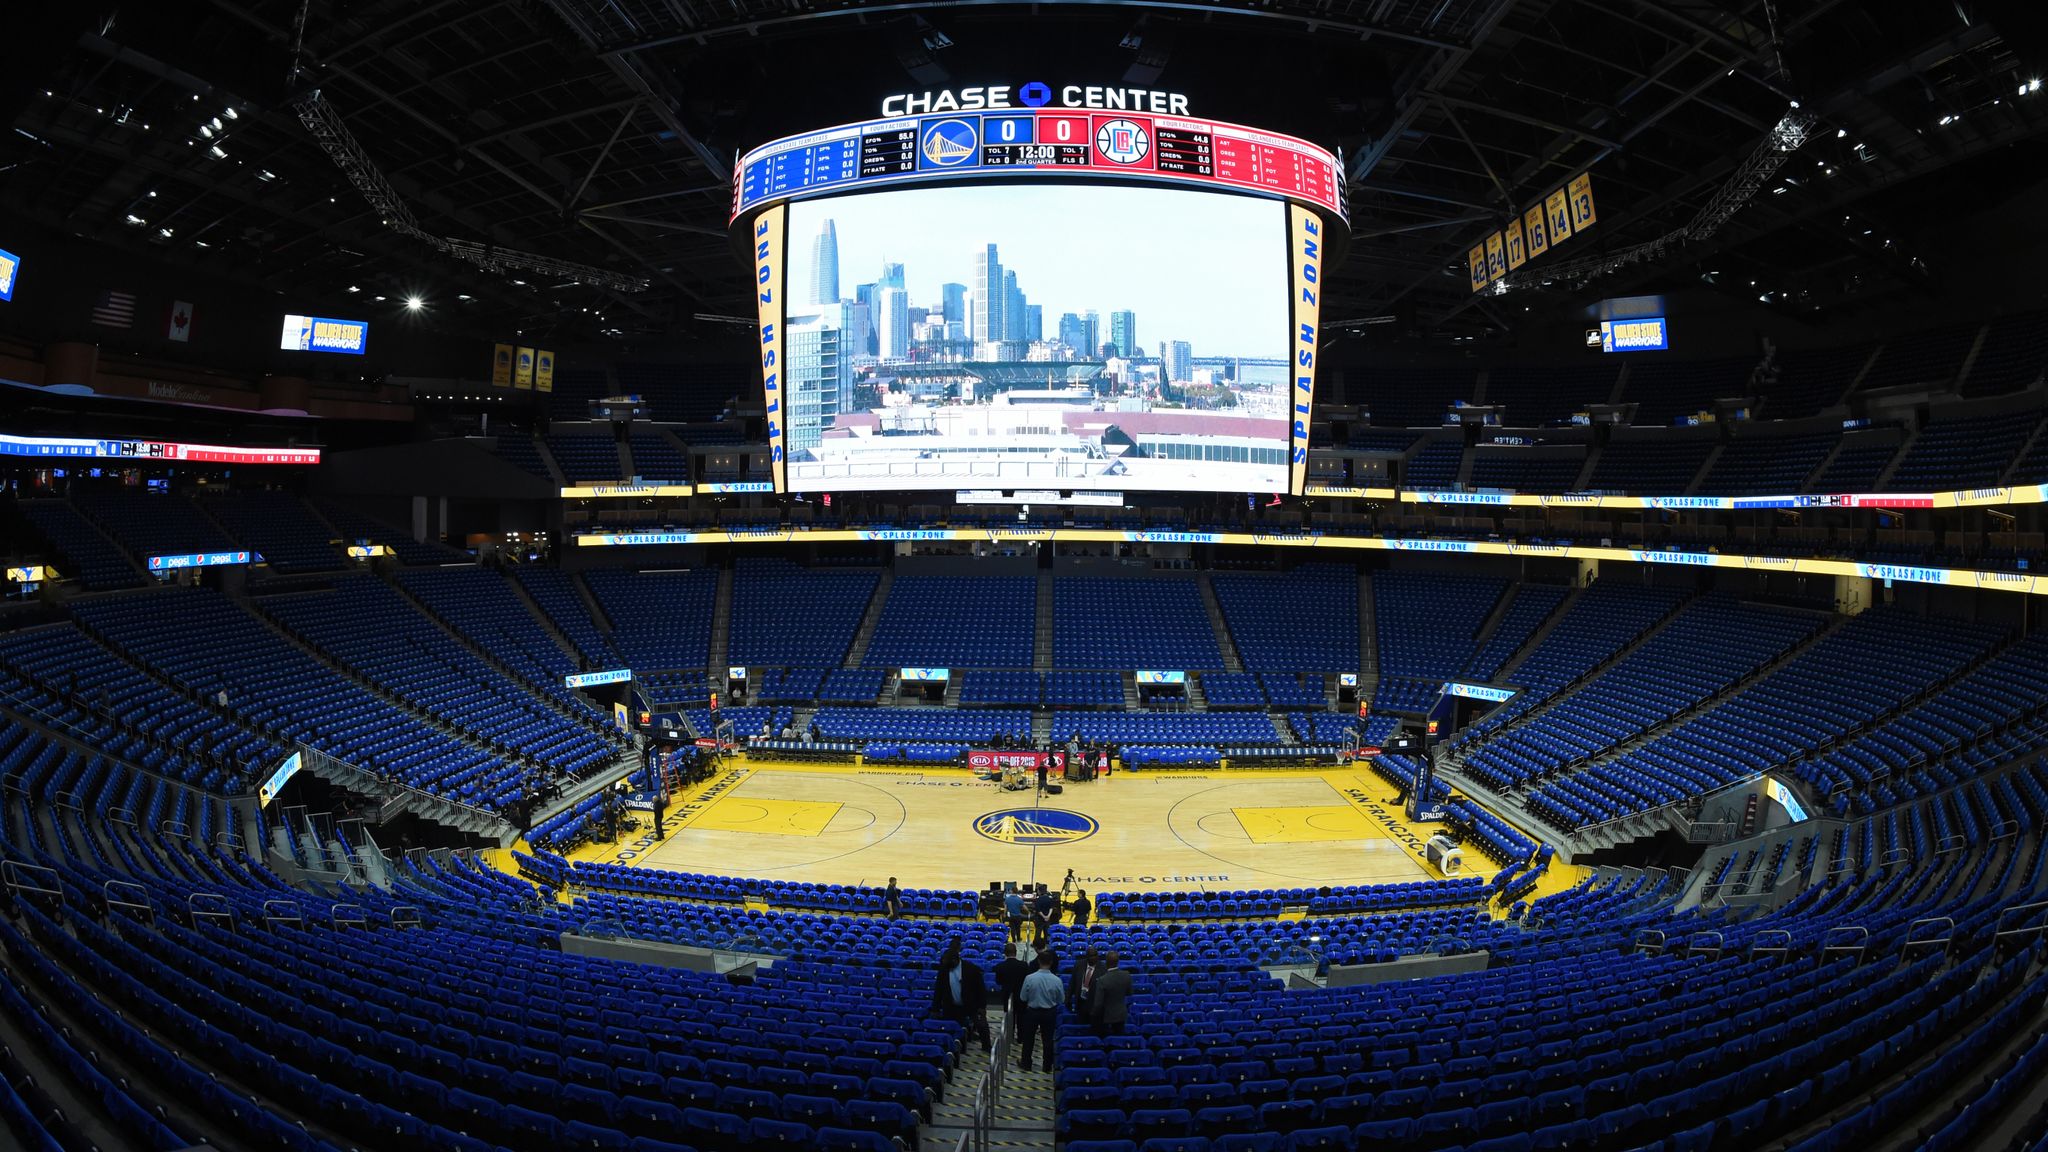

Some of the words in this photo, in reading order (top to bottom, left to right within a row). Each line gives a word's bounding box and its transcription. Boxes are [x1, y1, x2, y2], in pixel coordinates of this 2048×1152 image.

[882, 86, 1010, 117] CHASE
[1062, 86, 1190, 116] CENTER
[1002, 120, 1015, 140] 0
[1056, 120, 1070, 140] 0
[843, 150, 854, 158] 0.0
[1018, 146, 1055, 158] 12:00
[842, 160, 853, 168] 0.0
[901, 162, 912, 170] 0.0
[842, 170, 852, 178] 0.0
[1575, 194, 1590, 224] 13
[1552, 209, 1566, 238] 14
[1530, 224, 1543, 250] 16
[1510, 236, 1520, 262] 17
[757, 220, 772, 307] ZONE
[1303, 218, 1318, 307] ZONE
[1489, 248, 1504, 274] 24
[1473, 261, 1485, 284] 42
[314, 322, 342, 339] GOLDEN
[342, 325, 363, 340] STATE
[1641, 322, 1661, 337] STATE
[313, 336, 361, 350] WARRIORS
[1616, 336, 1662, 347] WARRIORS
[149, 382, 176, 398] Modelo
[762, 324, 781, 464] SPLASH
[1293, 323, 1315, 465] SPLASH
[168, 556, 190, 568] pepsi
[211, 554, 231, 565] pepsi
[1654, 553, 1684, 562] SPLASH
[1688, 555, 1708, 564] ZONE
[1881, 567, 1915, 579] SPLASH
[1920, 570, 1941, 581] ZONE
[581, 674, 608, 683] SPLASH
[1467, 687, 1494, 696] SPLASH
[661, 804, 702, 826] STATE
[692, 769, 750, 802] WARRIORS
[1344, 789, 1373, 802] SAN
